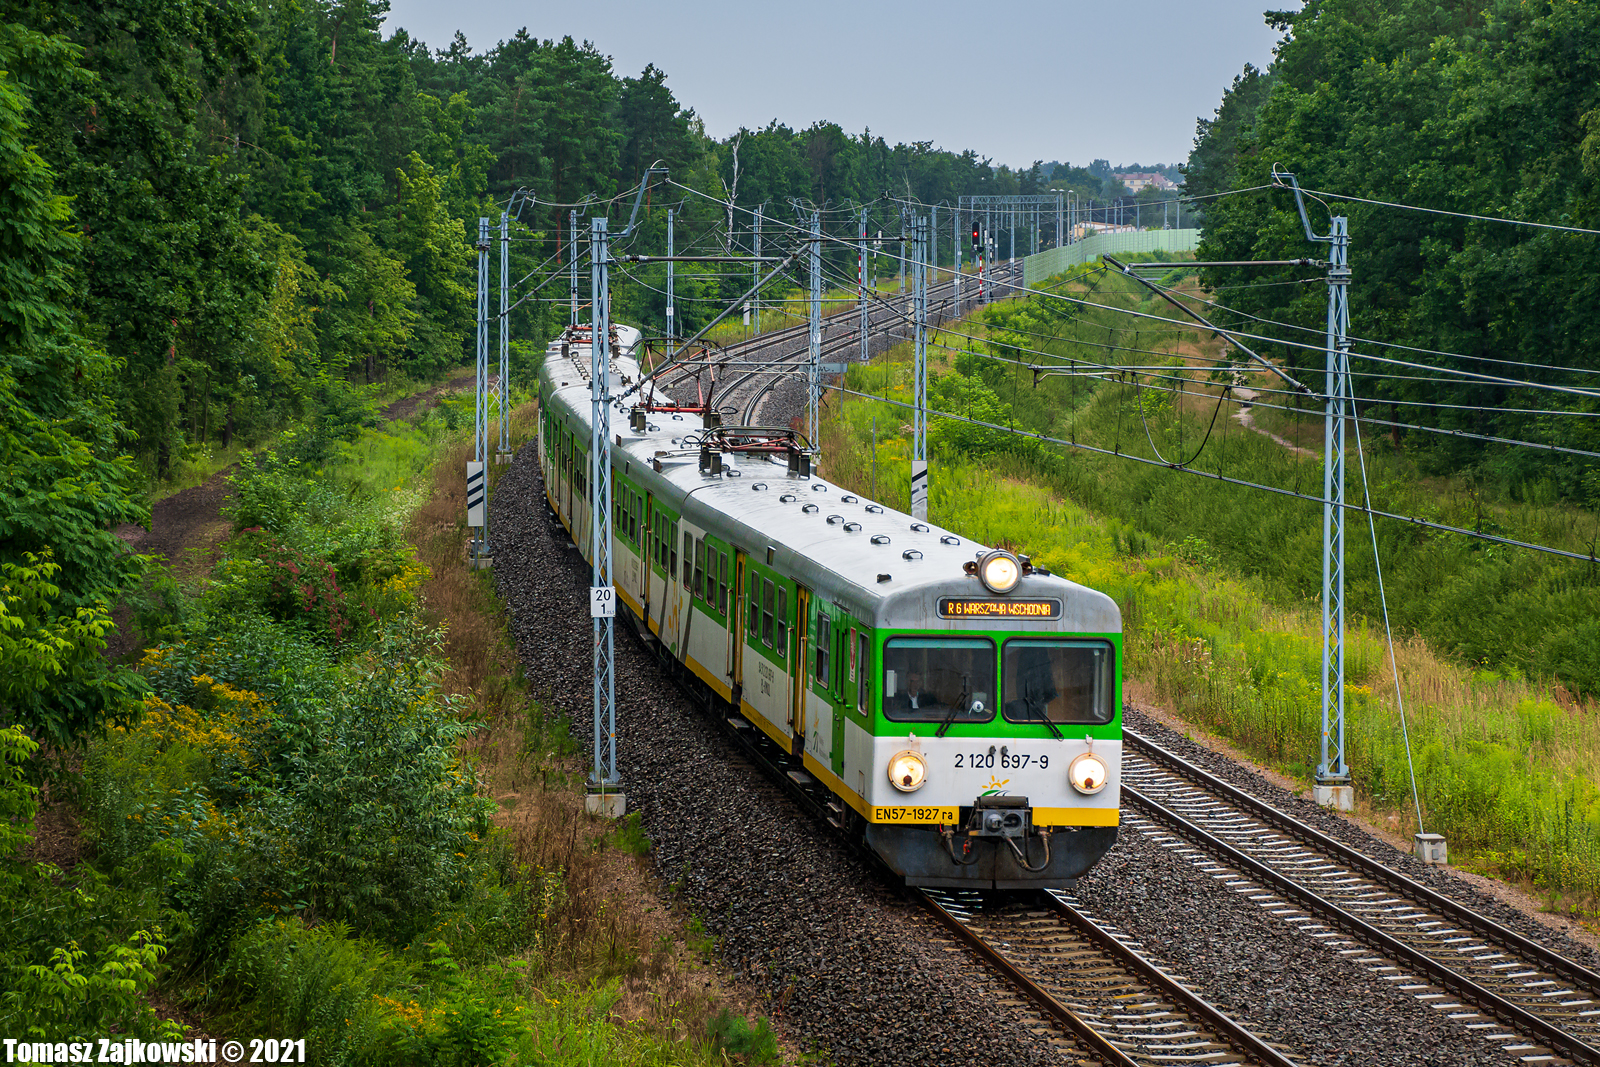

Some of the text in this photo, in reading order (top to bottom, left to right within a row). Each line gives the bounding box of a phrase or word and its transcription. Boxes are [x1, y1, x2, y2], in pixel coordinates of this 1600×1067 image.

[595, 589, 611, 601] 20
[600, 603, 606, 614] 1
[948, 602, 1051, 616] R 6 WARSZAWA WSCHODNIA
[954, 754, 1049, 769] 2 120 697-9
[876, 808, 953, 820] EN57-1927 ra
